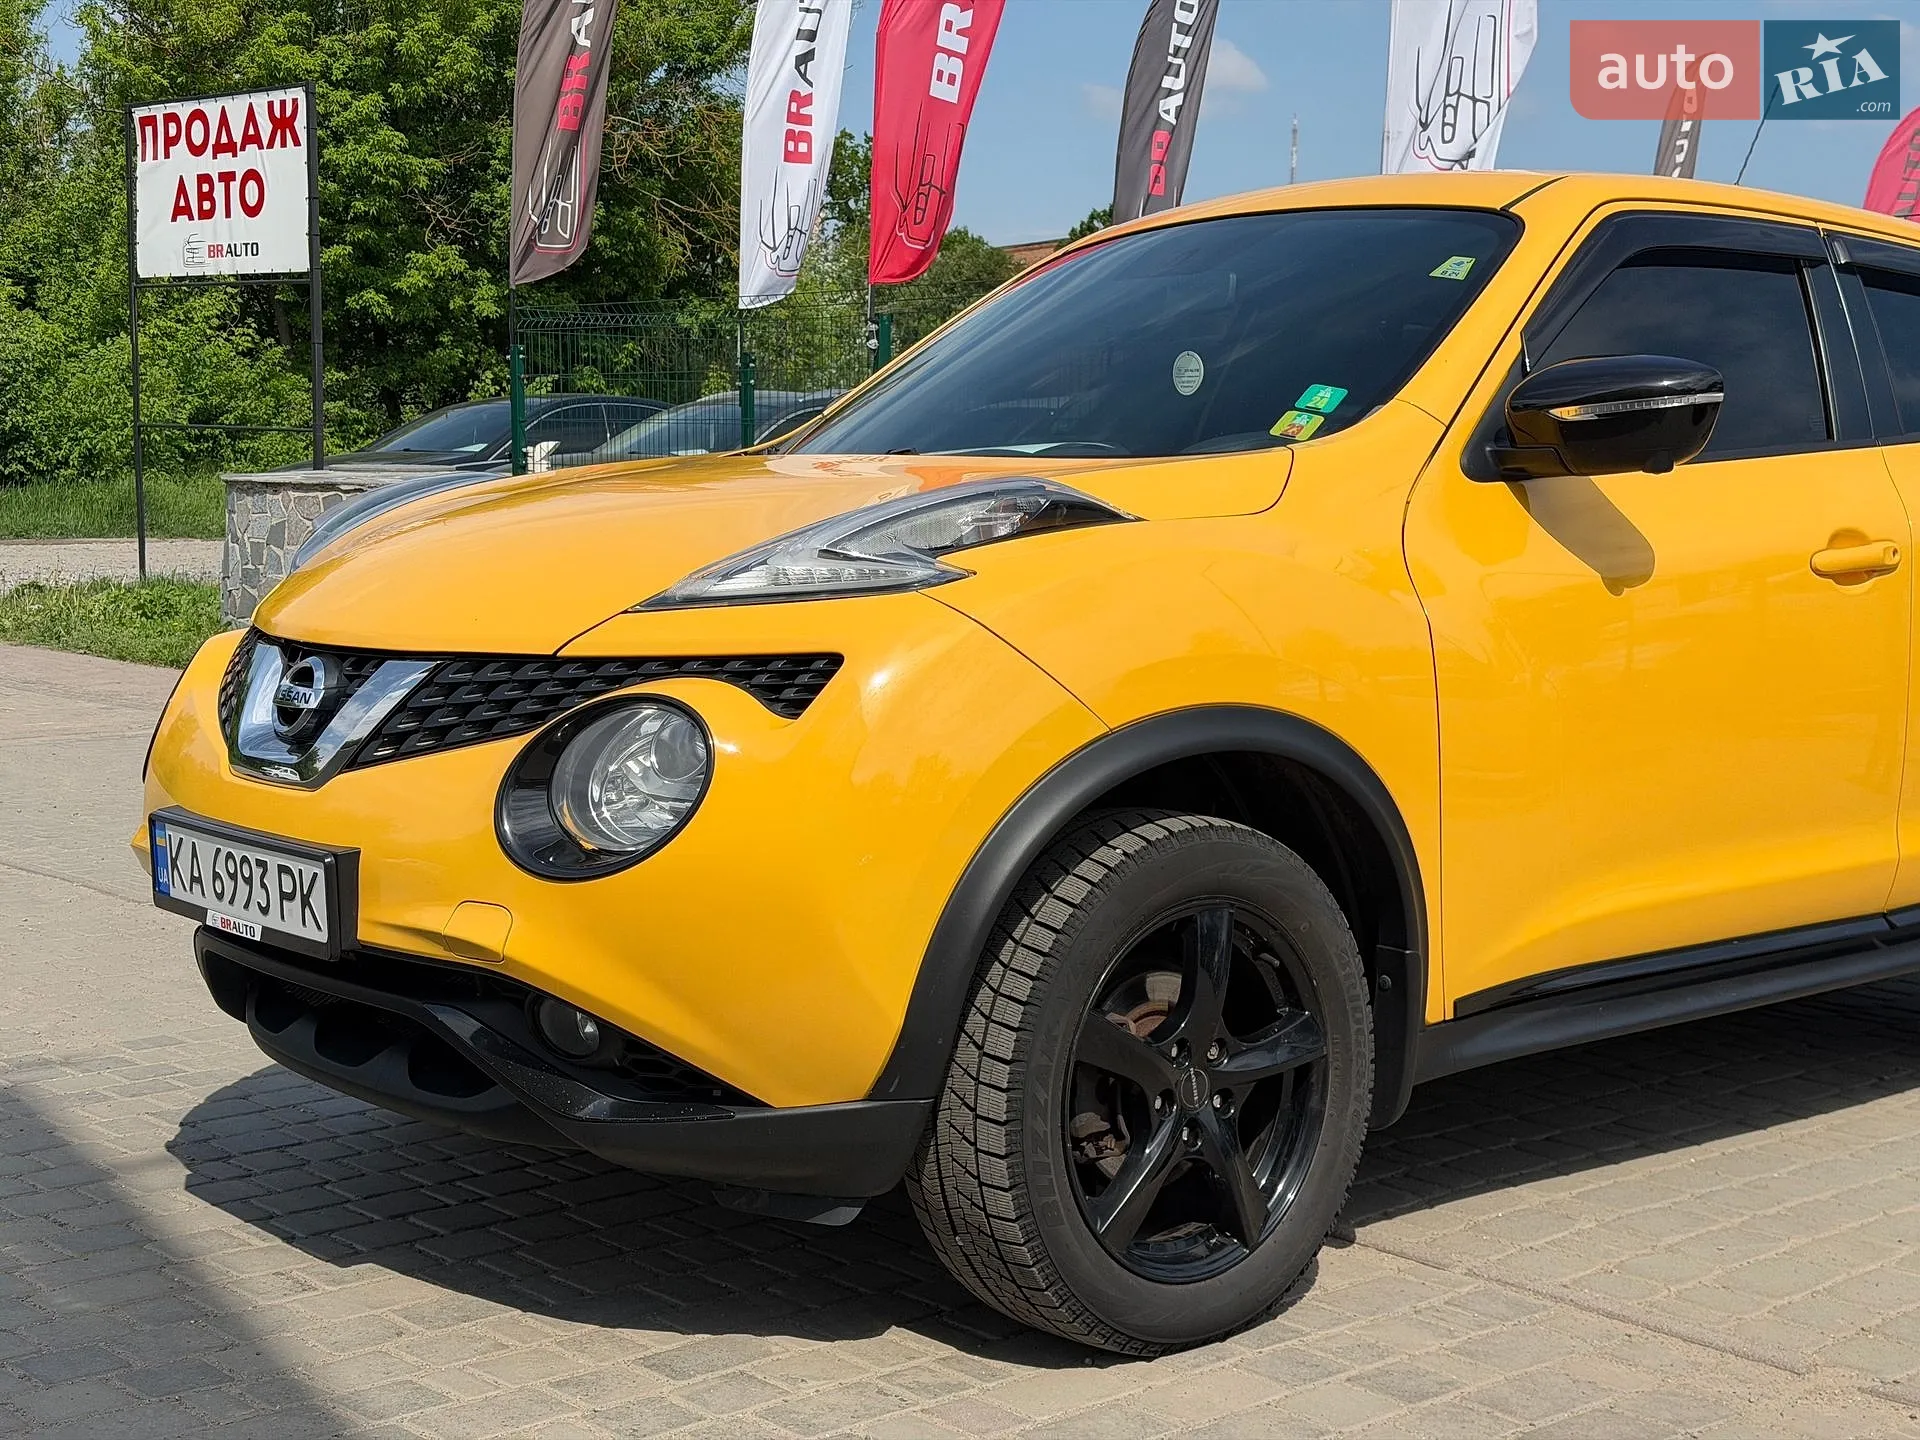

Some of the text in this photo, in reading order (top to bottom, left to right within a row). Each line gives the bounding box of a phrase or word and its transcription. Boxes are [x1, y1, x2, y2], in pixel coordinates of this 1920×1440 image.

[557, 0, 595, 130] BRA
[138, 97, 302, 163] ПРОДАЖ
[170, 168, 265, 223] АВТО
[207, 242, 260, 259] BRAUTO
[157, 866, 169, 885] UA
[167, 833, 323, 933] KA 6993 PK
[219, 916, 256, 938] BRAUTO
